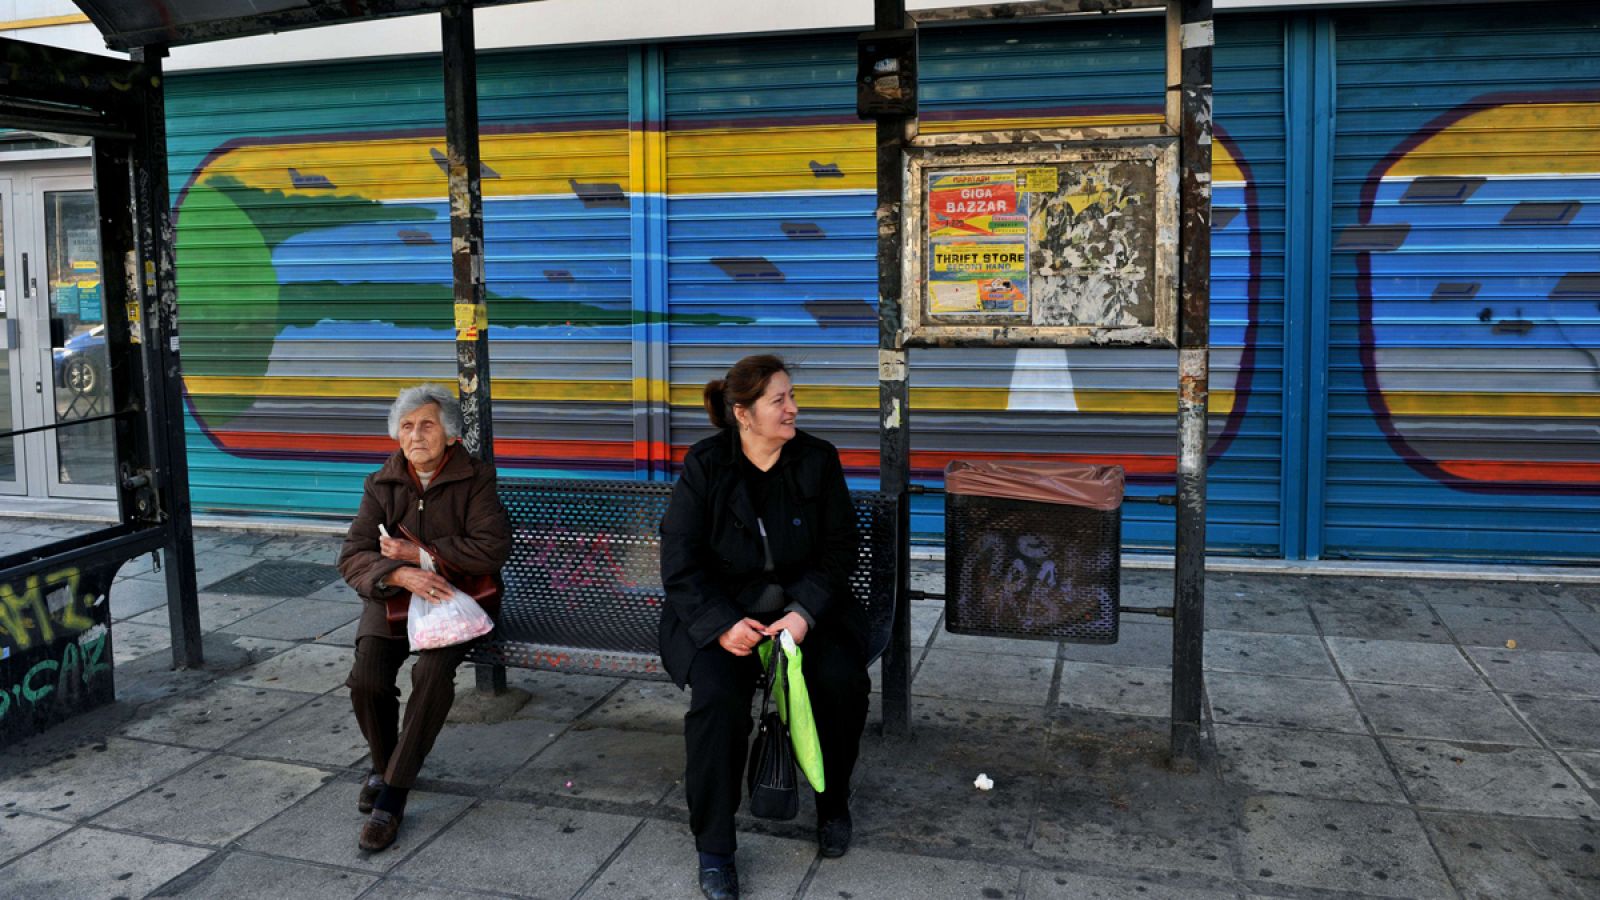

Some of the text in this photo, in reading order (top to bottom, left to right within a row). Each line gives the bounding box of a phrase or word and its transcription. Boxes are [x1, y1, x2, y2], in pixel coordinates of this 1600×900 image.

[961, 188, 993, 199] GIGA
[946, 200, 1007, 213] BAZZAR
[936, 253, 1025, 264] THRIFT STORE
